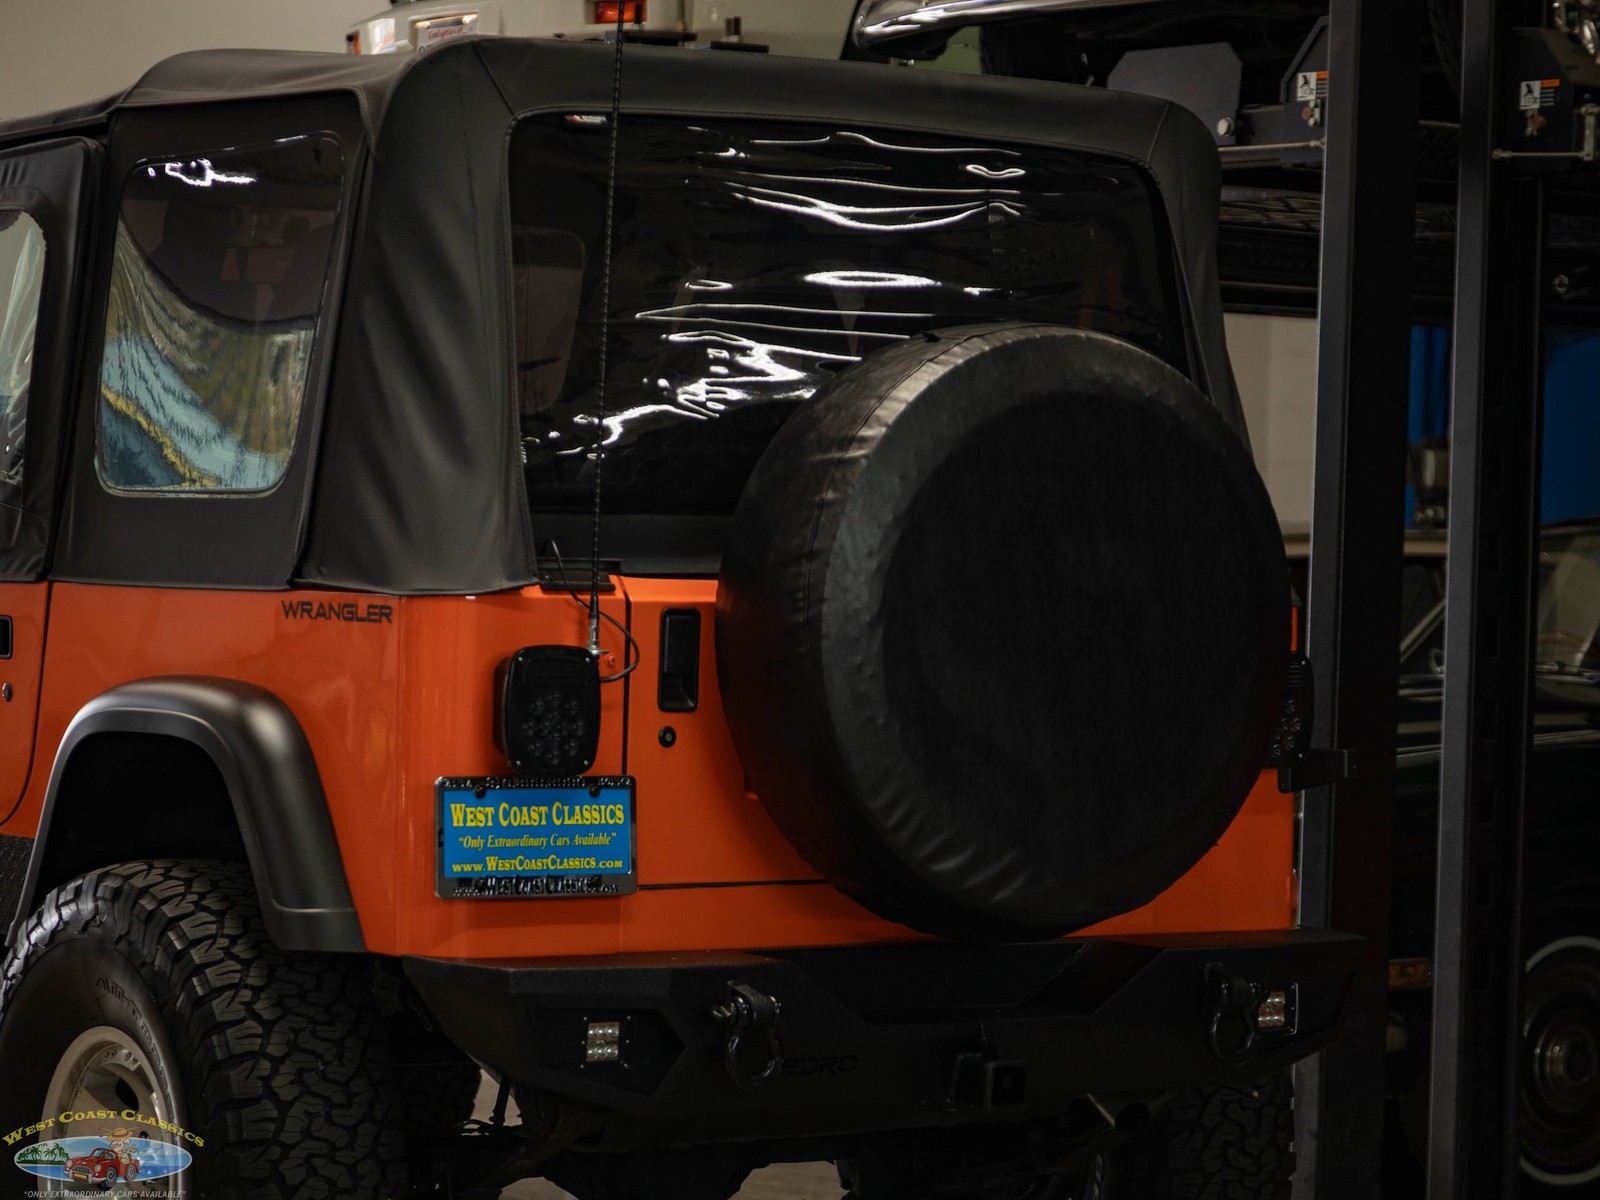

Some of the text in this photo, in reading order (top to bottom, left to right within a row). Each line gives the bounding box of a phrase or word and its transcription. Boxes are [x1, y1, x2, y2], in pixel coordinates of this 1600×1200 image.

[281, 600, 393, 624] WRANGLER
[450, 801, 625, 827] WEST COAST CLASSICS
[458, 832, 617, 851] "Only Extraordinary Cars Available"
